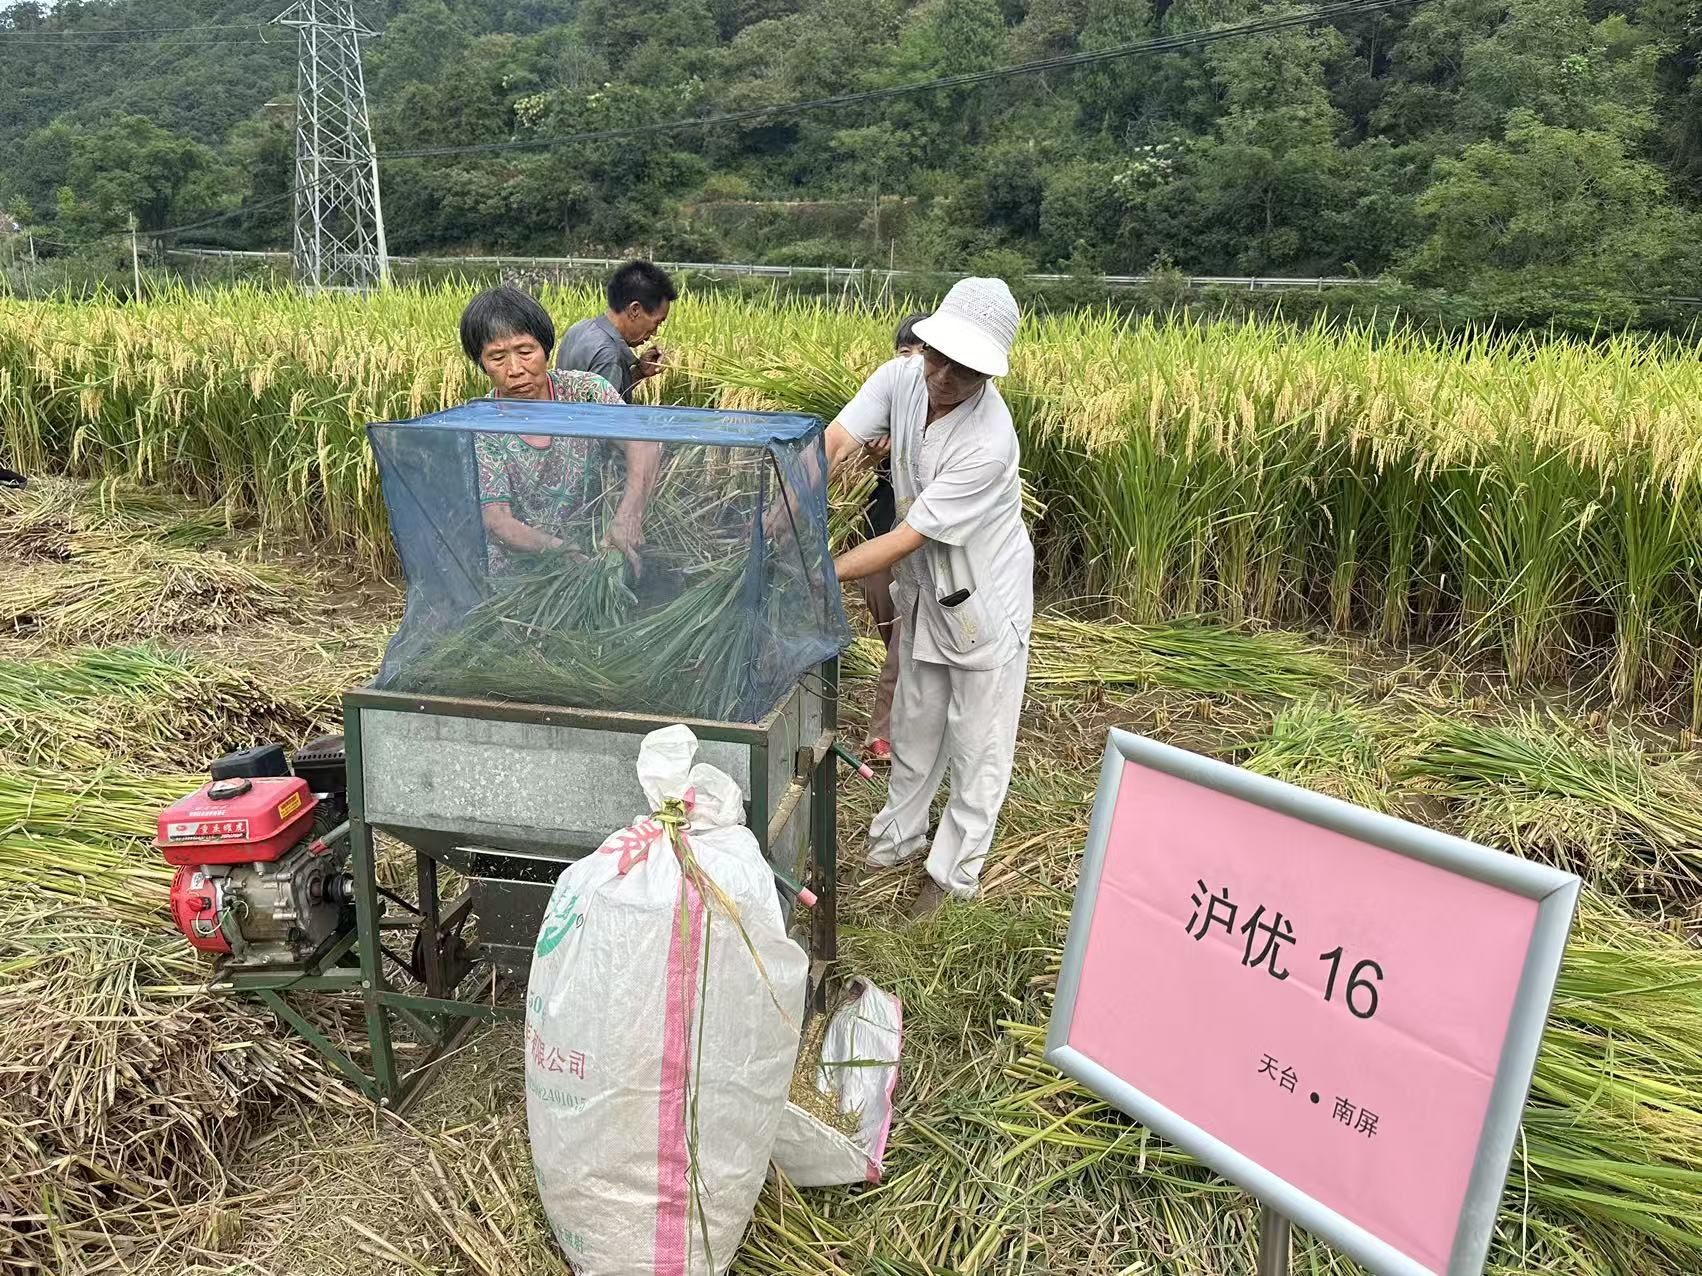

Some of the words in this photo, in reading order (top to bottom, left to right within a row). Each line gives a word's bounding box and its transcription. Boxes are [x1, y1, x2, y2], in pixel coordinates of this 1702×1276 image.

[1185, 879, 1297, 981] 沪优
[1319, 946, 1384, 1019] 16
[1257, 1053, 1299, 1094] 天台
[1332, 1096, 1380, 1138] 南屏
